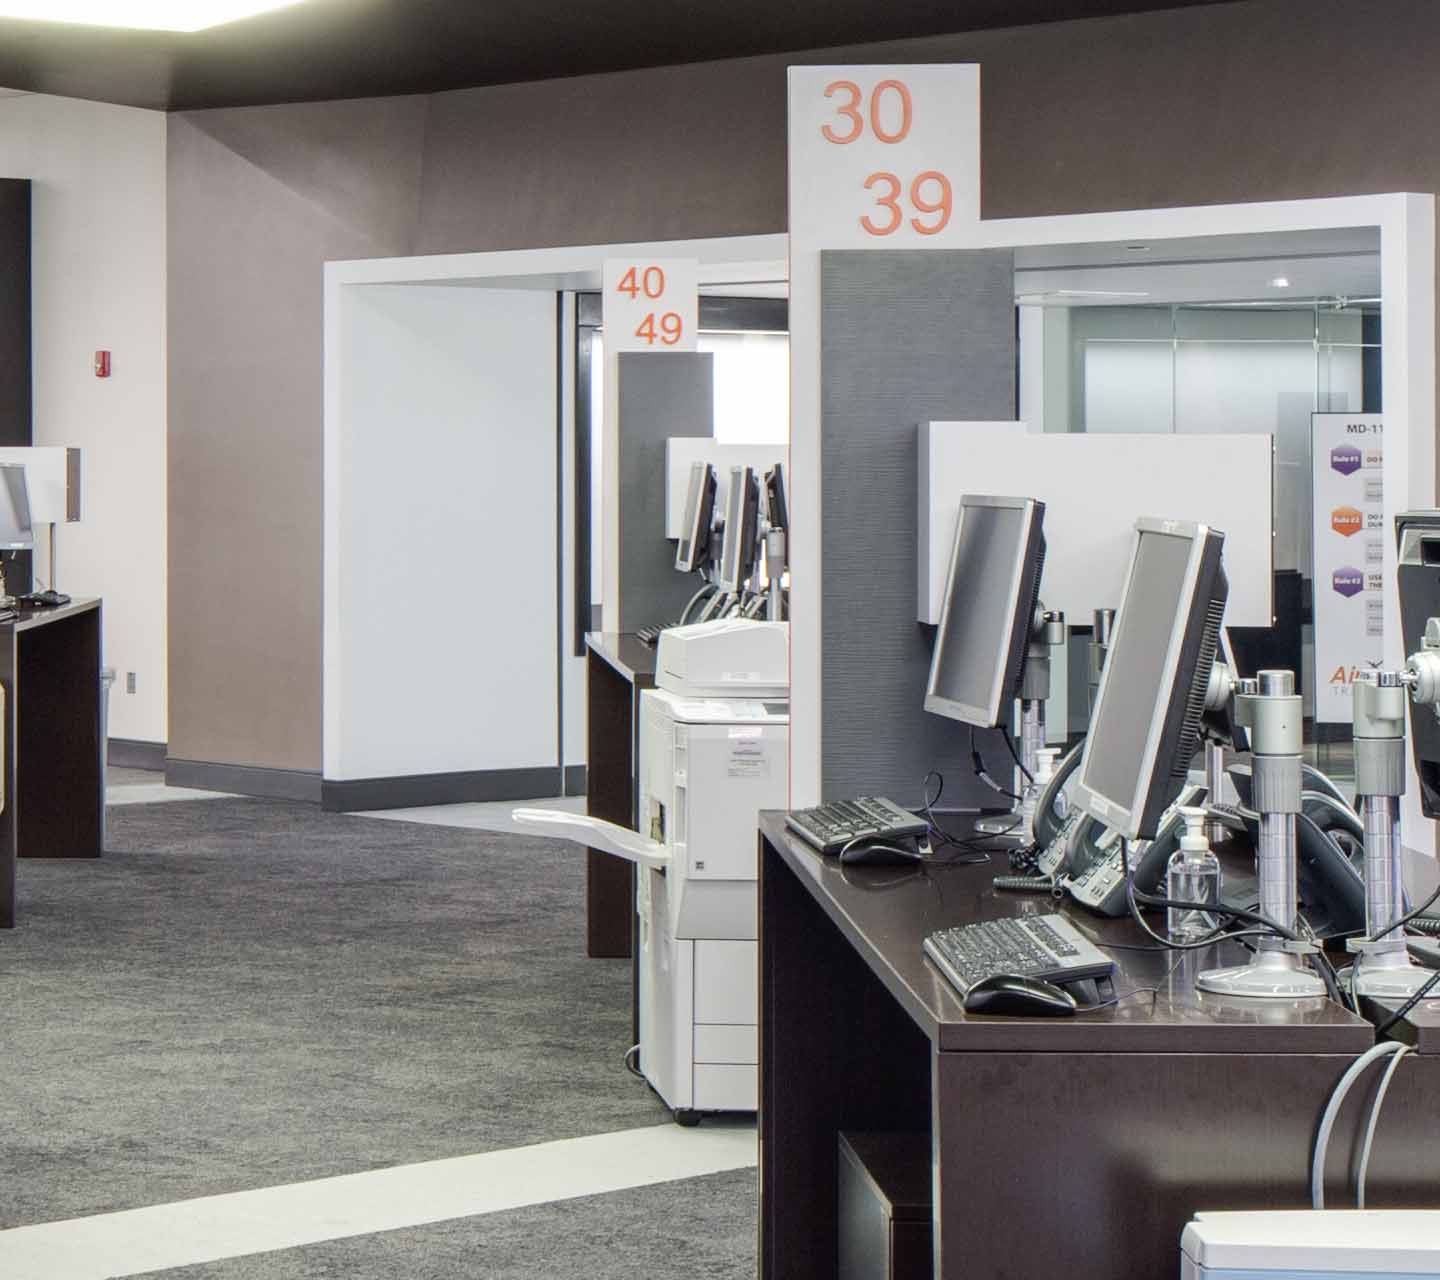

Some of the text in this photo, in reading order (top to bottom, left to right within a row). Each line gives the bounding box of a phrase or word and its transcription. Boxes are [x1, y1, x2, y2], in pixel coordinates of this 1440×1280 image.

[821, 79, 912, 145] 30
[859, 170, 954, 237] 39
[616, 265, 666, 300] 40
[634, 311, 682, 346] 49
